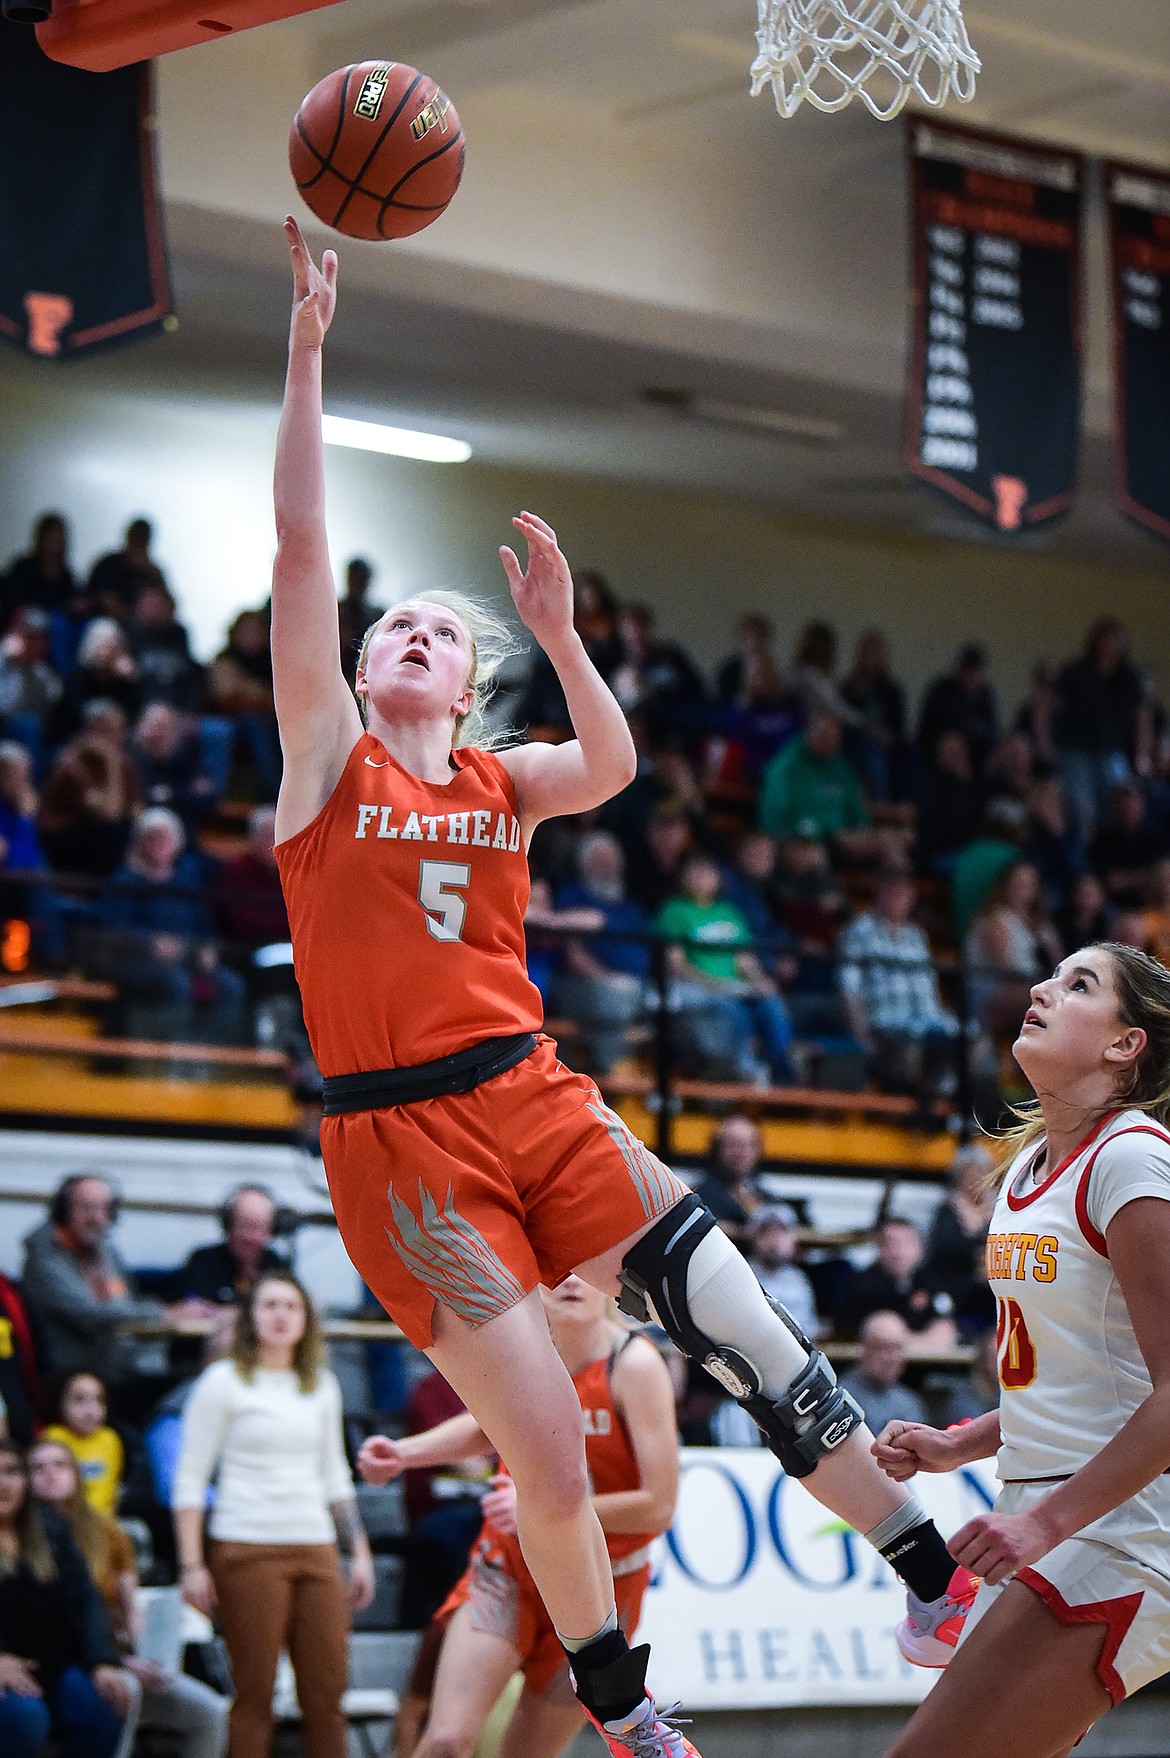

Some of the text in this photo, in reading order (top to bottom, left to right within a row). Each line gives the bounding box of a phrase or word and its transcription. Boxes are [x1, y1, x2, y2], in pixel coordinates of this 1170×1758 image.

[358, 81, 384, 118] PRO
[354, 804, 521, 853] FLATHEAD
[417, 859, 471, 943] 5
